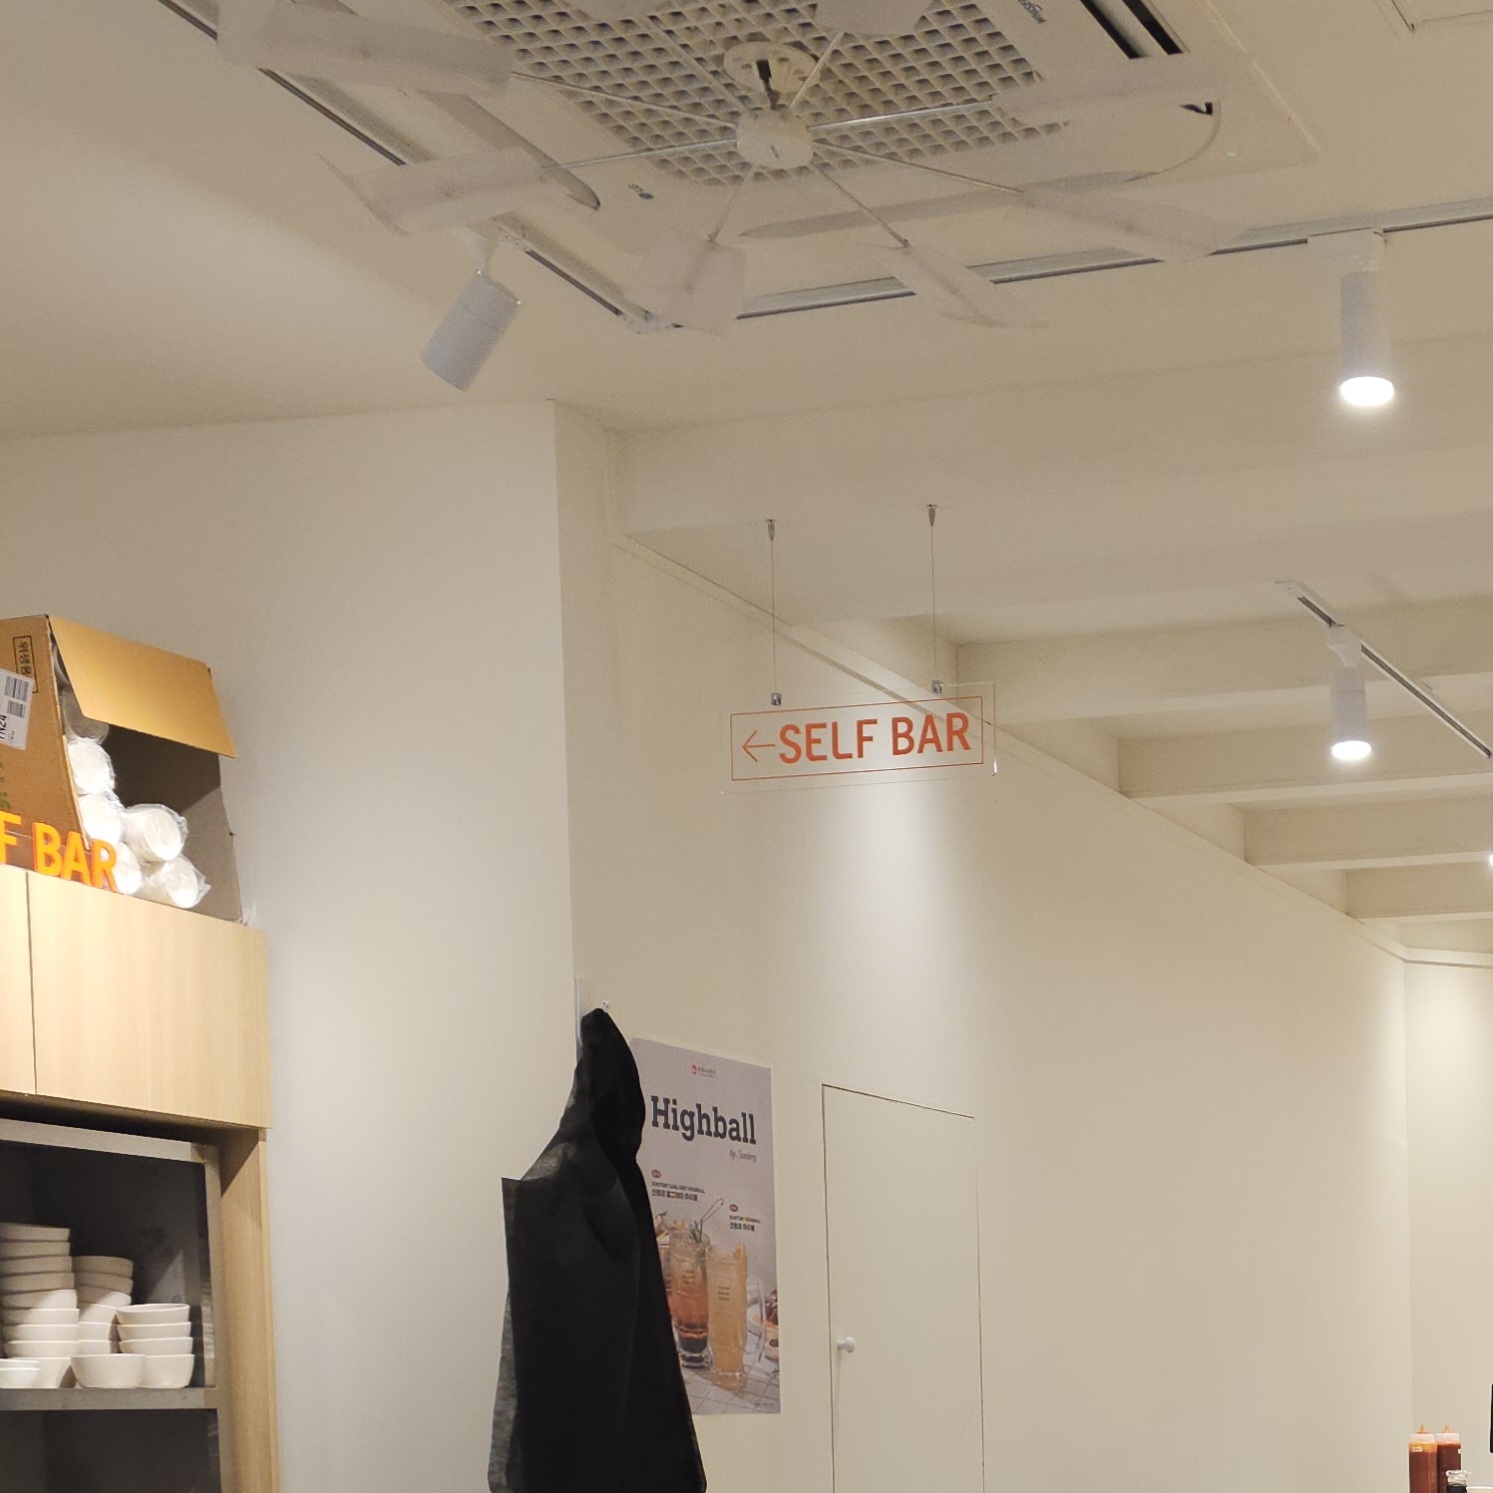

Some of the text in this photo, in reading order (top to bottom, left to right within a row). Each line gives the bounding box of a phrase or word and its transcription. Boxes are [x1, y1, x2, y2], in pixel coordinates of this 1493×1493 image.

[778, 712, 972, 765] SELF BAR
[32, 821, 118, 893] BAR
[650, 1094, 757, 1145] Highball
